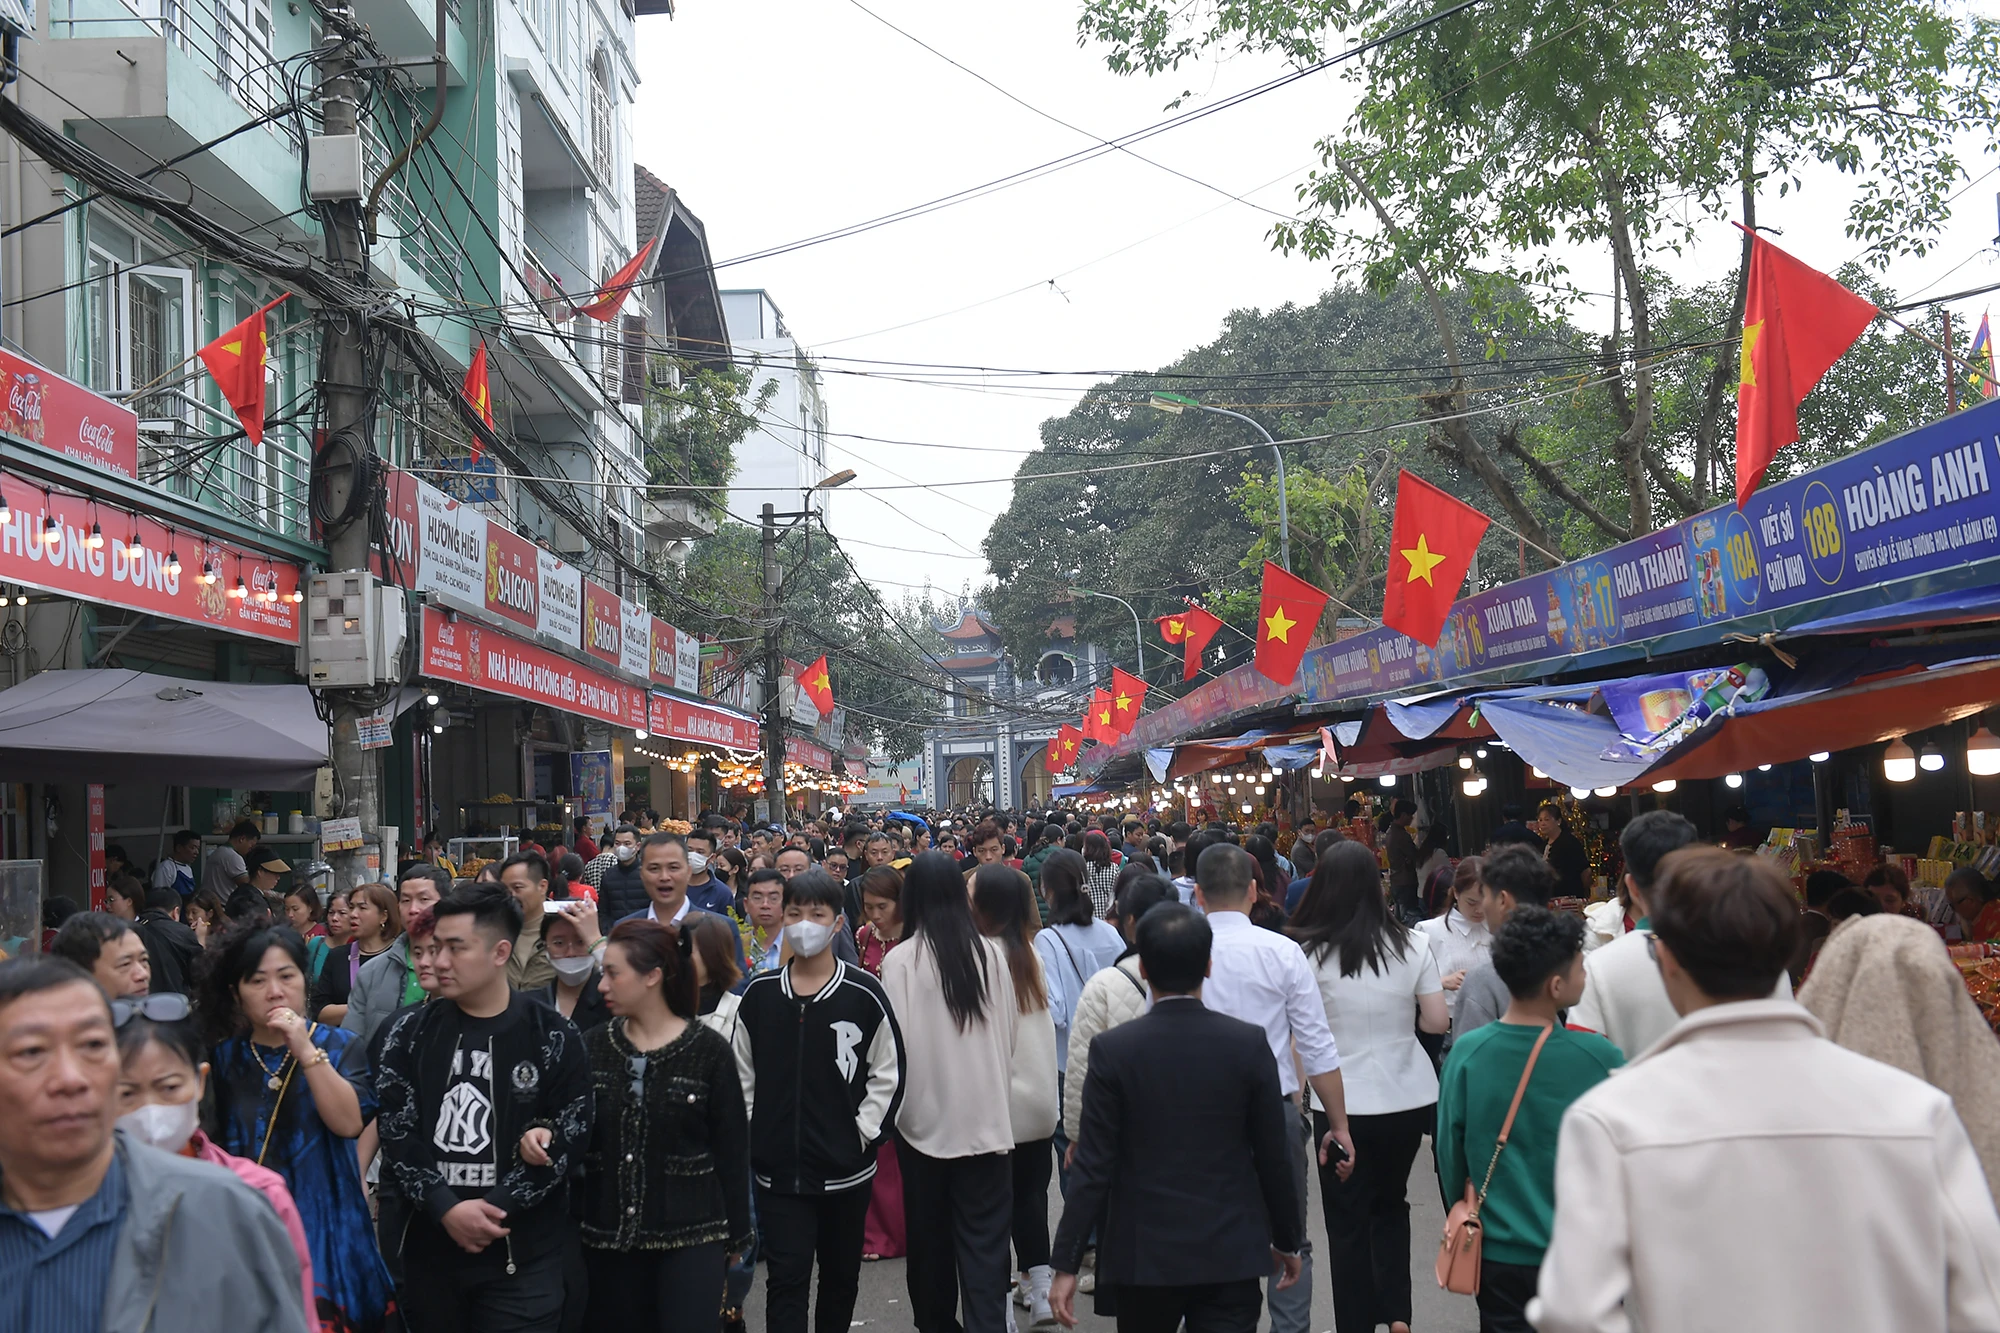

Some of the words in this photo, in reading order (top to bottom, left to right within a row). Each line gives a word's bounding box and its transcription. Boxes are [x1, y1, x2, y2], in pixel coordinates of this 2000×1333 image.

[65, 445, 82, 461] KHAI
[1843, 464, 1928, 532] HOÀNG
[1931, 441, 1989, 507] ANH
[3, 508, 104, 577] HƯƠNG
[428, 515, 460, 553] HƯƠNG
[461, 530, 479, 562] HIẾU
[1760, 503, 1781, 547] VIẾT
[1780, 501, 1794, 541] SỐ
[1804, 502, 1841, 559] 18B
[1854, 545, 1877, 572] CHUYÊN
[1888, 535, 1898, 563] LỄ
[1895, 536, 1914, 561] VÀNG
[1912, 532, 1935, 558] HƯƠNG
[1934, 528, 1950, 552] HOA
[1948, 520, 1964, 550] QUẢ
[1962, 517, 1984, 545] BÁNH
[1982, 515, 1998, 543] KẸO
[1613, 561, 1643, 599] HOA
[1640, 543, 1688, 590] THÀNH
[1726, 530, 1759, 582] 18A
[1766, 553, 1786, 593] CHỮ
[1784, 553, 1807, 588] NHO
[498, 565, 535, 615] SAIGON
[1595, 575, 1615, 628] 17
[278, 615, 291, 629] CÔNG
[594, 617, 619, 654] SAIGON
[1467, 613, 1484, 655] 16
[1484, 598, 1512, 635] XUÂN
[1511, 596, 1538, 628] HOA
[655, 647, 674, 677] SAIGON
[1379, 637, 1397, 664] ÔNG
[488, 650, 507, 682] NHÀ
[508, 654, 532, 690] HÀNG
[533, 663, 560, 697] HƯƠNG
[560, 671, 576, 702] HIẾU
[580, 682, 588, 706] 25
[91, 827, 105, 851] TÔM
[92, 868, 105, 887] CUA
